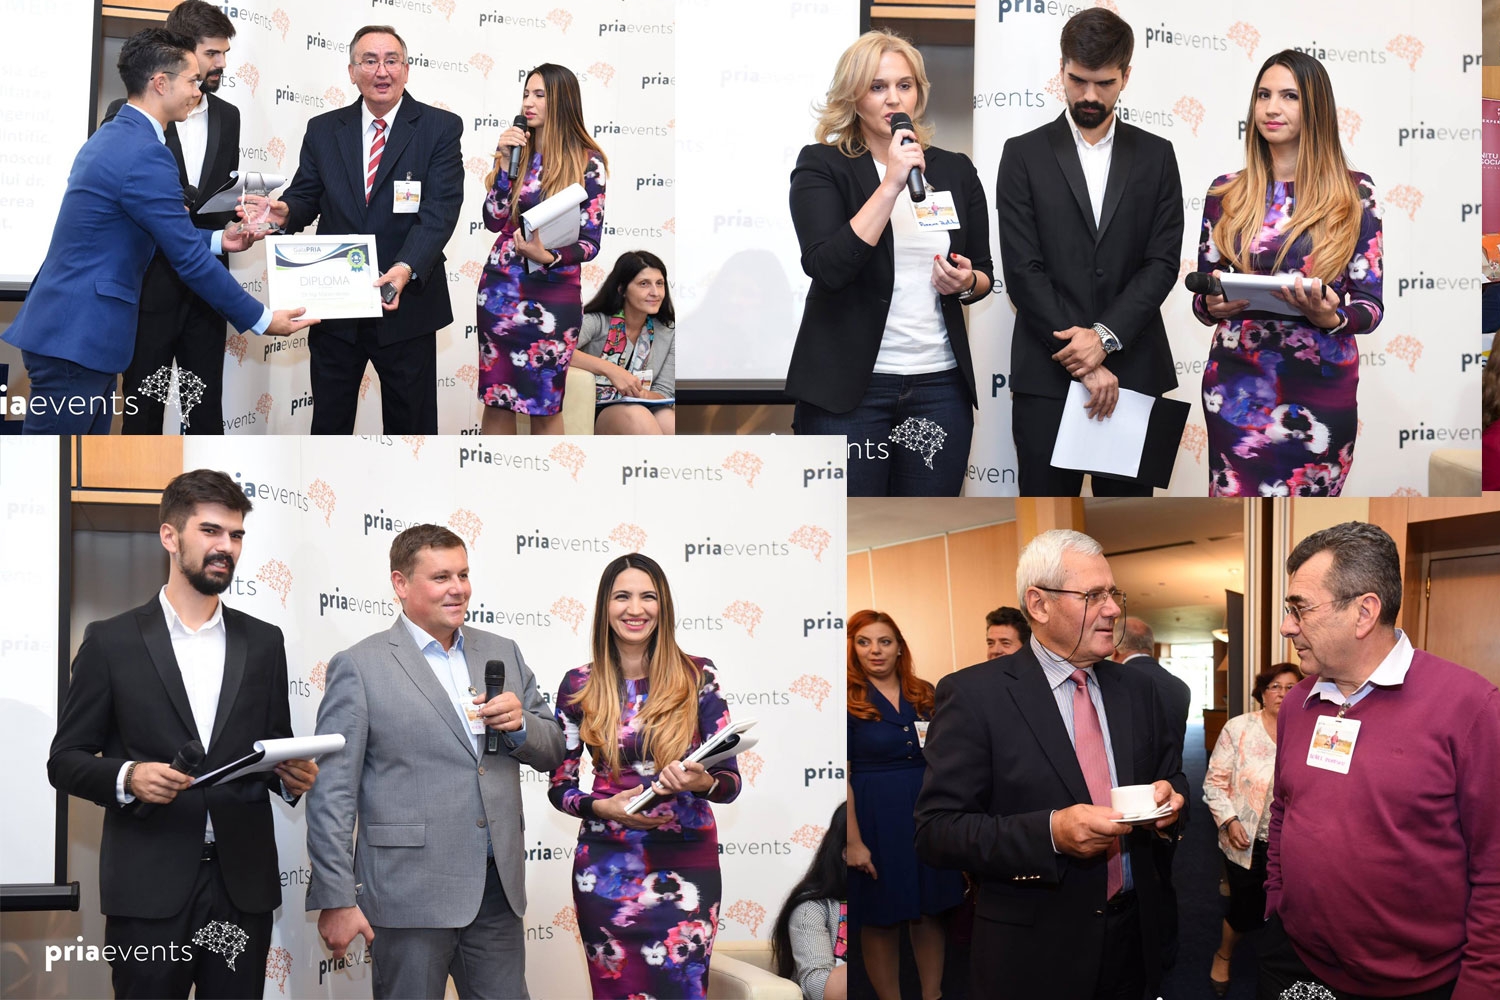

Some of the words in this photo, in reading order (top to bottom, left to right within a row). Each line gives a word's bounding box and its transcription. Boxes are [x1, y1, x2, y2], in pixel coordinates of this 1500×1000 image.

[479, 11, 546, 28] priaevents
[599, 20, 672, 36] priaevents
[1146, 24, 1227, 52] priaevents
[276, 86, 324, 108] priaevents
[594, 122, 667, 138] priaevents
[300, 275, 350, 286] DIPLOMA
[460, 443, 550, 472] priaevents
[622, 459, 723, 485] priaevents
[516, 530, 609, 554] priaevents
[685, 537, 789, 562] priaevents
[320, 587, 394, 616] priaevents
